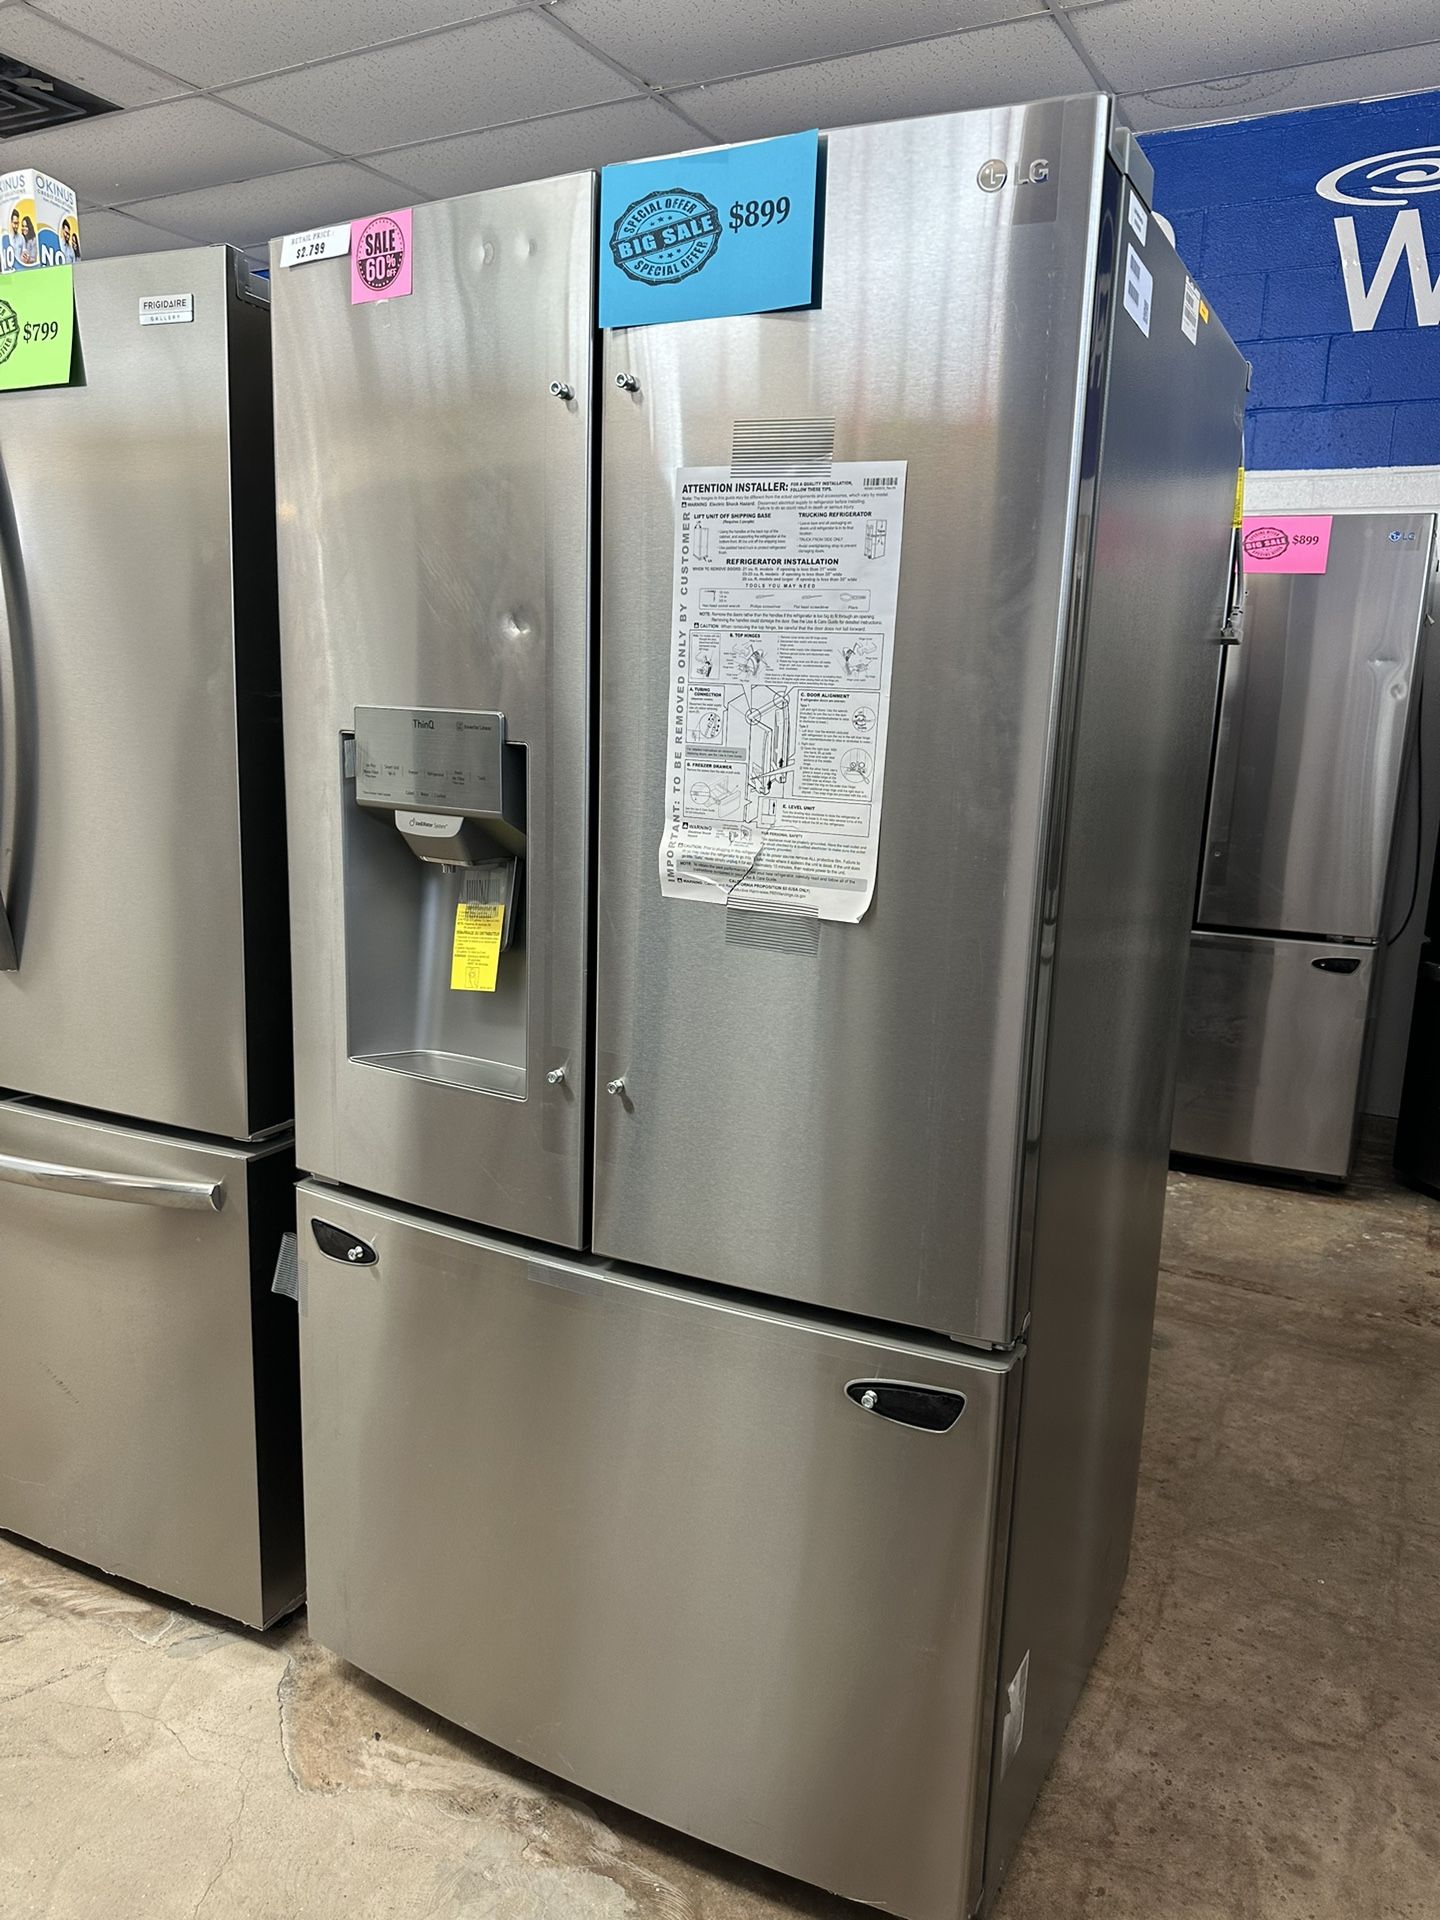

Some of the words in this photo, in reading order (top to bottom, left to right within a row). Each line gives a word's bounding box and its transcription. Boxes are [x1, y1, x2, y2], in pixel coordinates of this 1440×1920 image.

[0, 174, 25, 192] INUS
[1014, 158, 1049, 186] LG
[36, 175, 74, 206] OKINUS
[624, 200, 662, 233] SPECIAL
[665, 198, 697, 214] OFFER
[728, 196, 791, 233] $899
[291, 234, 311, 245] RETAIL
[365, 229, 396, 256] SALE
[617, 234, 657, 259] BIG
[661, 215, 714, 245] SALE
[634, 260, 680, 276] SPECIAL
[680, 241, 708, 269] OFFER
[143, 299, 187, 309] FRIGIDAIRE
[150, 314, 180, 322] GALLERY
[23, 321, 59, 344] $799
[683, 484, 733, 494] ATTENTION
[735, 483, 789, 493] INSTALLER:
[1245, 541, 1263, 550] BIG
[1263, 537, 1287, 547] SALE
[1292, 534, 1319, 546] $899
[681, 512, 690, 595] CUSTOMER
[680, 603, 687, 622] BY
[678, 630, 686, 668] ONLY
[675, 676, 685, 744] REMOVED
[412, 719, 435, 729] ThinQ
[674, 752, 682, 768] BE
[673, 776, 681, 793] TO
[667, 801, 680, 882] IMPORTANT:
